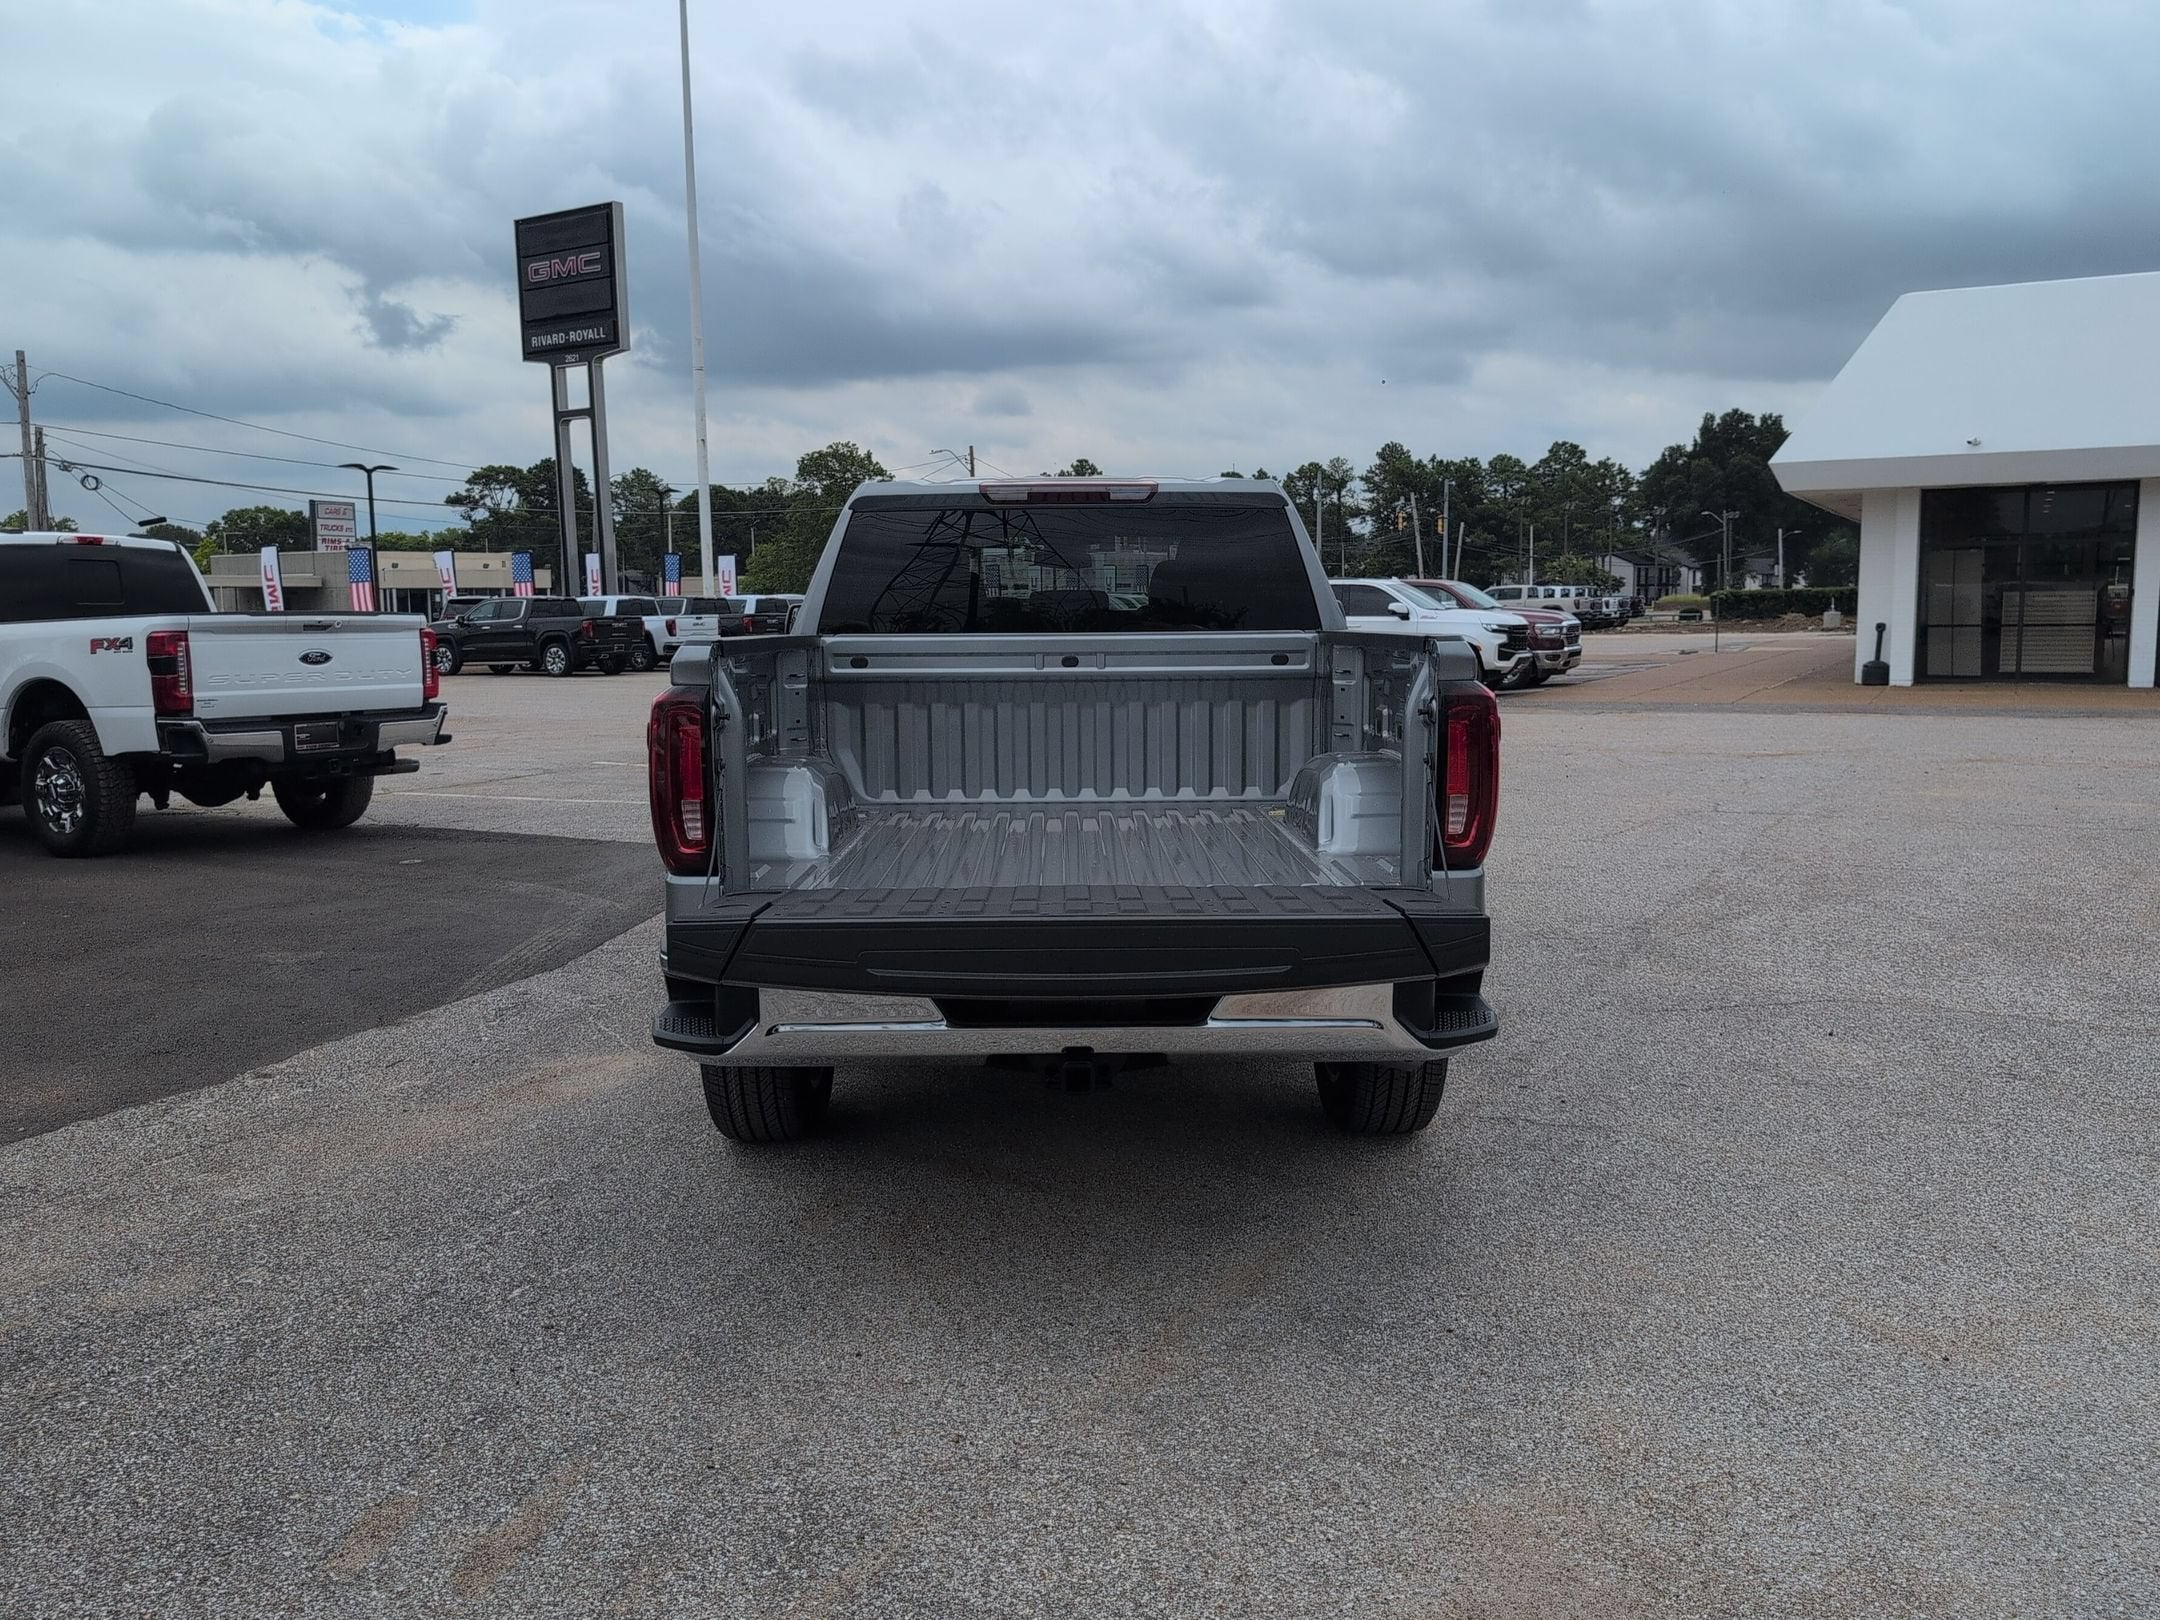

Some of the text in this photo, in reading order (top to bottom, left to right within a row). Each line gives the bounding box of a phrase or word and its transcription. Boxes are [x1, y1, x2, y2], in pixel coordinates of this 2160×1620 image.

[528, 252, 601, 282] GMC
[532, 327, 606, 348] RIVARD-ROYALL
[320, 524, 344, 532] TRUCKS
[321, 537, 342, 545] RIMS
[90, 636, 133, 654] FX4
[307, 652, 326, 662] Ford
[208, 668, 412, 686] SUPER DUTY
